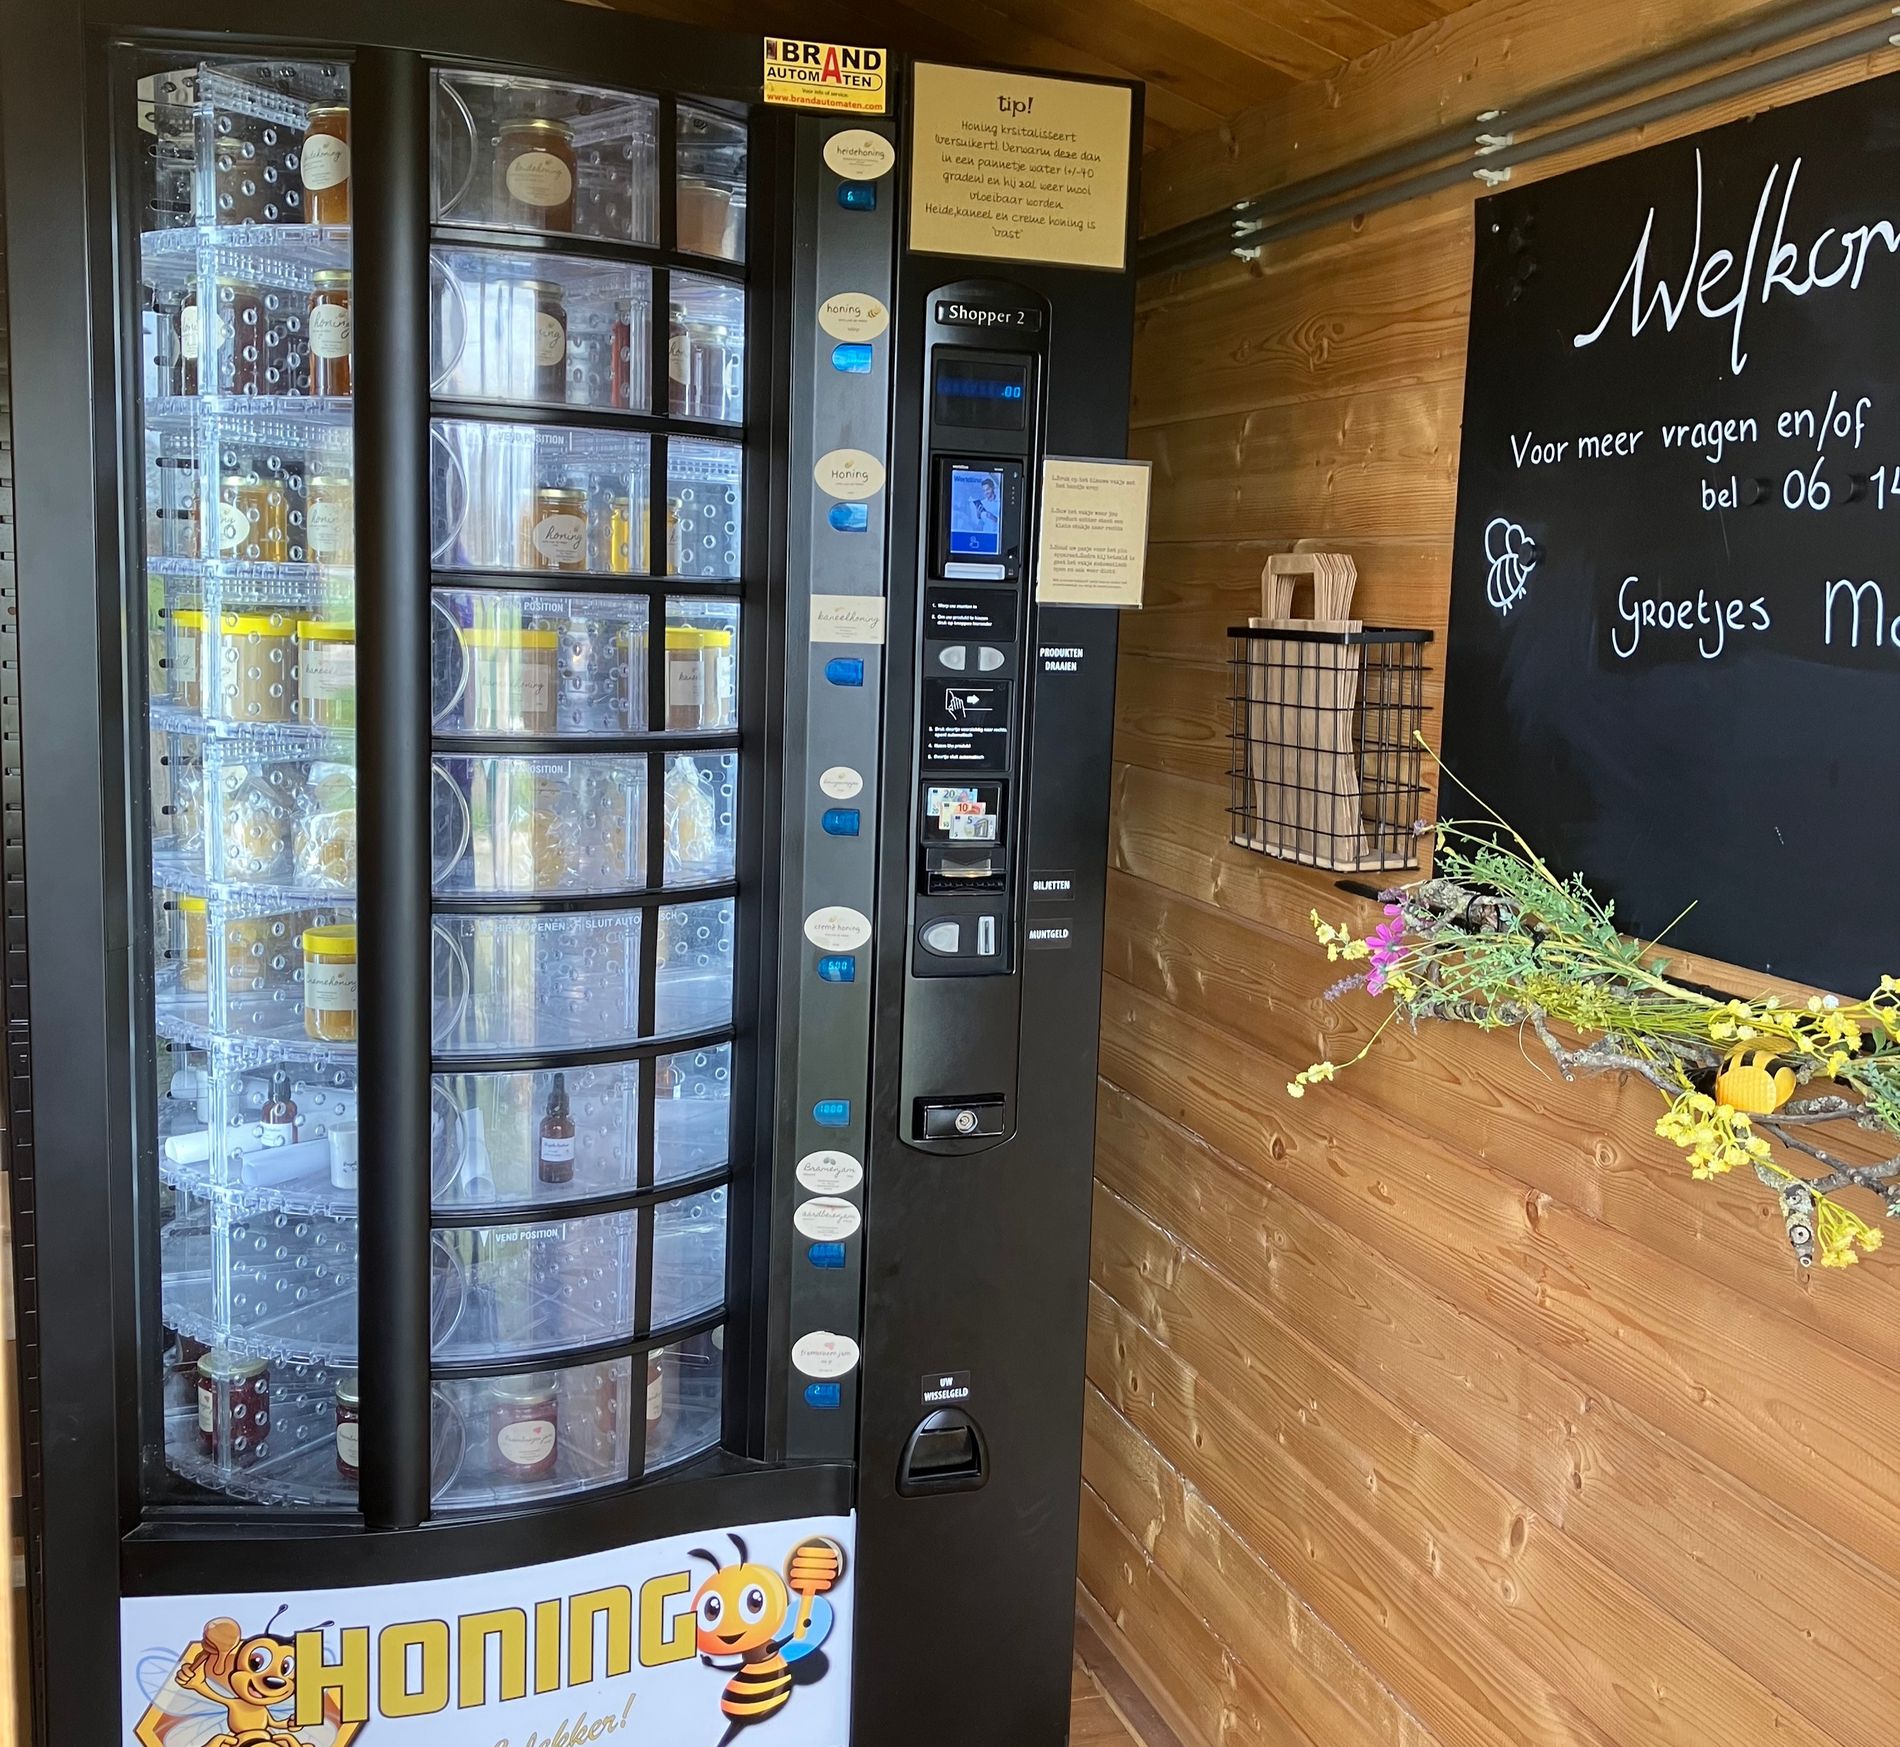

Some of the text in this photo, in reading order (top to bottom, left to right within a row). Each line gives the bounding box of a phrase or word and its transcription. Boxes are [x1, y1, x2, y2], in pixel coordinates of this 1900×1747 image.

[782, 41, 881, 84] BRAND
[767, 62, 872, 87] AUTOMATEN
[766, 93, 883, 111] www.brandautomaten.com
[997, 95, 1034, 117] tip!
[961, 120, 1077, 143] Honing krsitalisseert
[836, 145, 885, 160] heidehoning
[1002, 141, 1051, 157] Verwarm
[1053, 148, 1078, 160] deze
[1080, 150, 1101, 162] dan
[941, 154, 952, 163] in
[955, 156, 975, 165] een
[978, 158, 1026, 173] pannetje
[1029, 164, 1062, 175] water
[987, 177, 1000, 186] en
[1003, 176, 1017, 188] hij
[1018, 179, 1036, 190] zal
[1040, 182, 1065, 192] weer
[1066, 185, 1092, 196] mooi
[969, 191, 1023, 205] vloeibaar
[925, 202, 1097, 231] Heide,kaneel en creme honing is
[826, 303, 861, 318] honing
[948, 305, 1025, 326] Shopper 2
[1511, 390, 1871, 468] Voor meer vragen en/of
[526, 433, 565, 445] PSITION
[831, 469, 869, 483] Honing
[1701, 475, 1738, 511] bel
[1782, 456, 1831, 511] 06
[545, 525, 582, 550] honing
[524, 601, 564, 612] POSITION
[817, 609, 880, 629] kaneelhoning
[1612, 576, 1771, 659] Groetjes
[1039, 647, 1084, 658] PRODUKTEN
[1044, 661, 1077, 672] DRAAIEN
[525, 765, 564, 774] OSITION
[943, 790, 956, 799] 20
[958, 803, 968, 812] 10
[967, 816, 973, 824] 5
[1032, 880, 1071, 891] BILJETTEN
[585, 918, 613, 929] SLUIT
[837, 924, 861, 934] honing
[1028, 928, 1069, 940] MUNTGELD
[495, 1228, 558, 1242] VEND POSITION
[940, 1377, 954, 1387] UW
[923, 1387, 969, 1402] WISSELGELD
[295, 1570, 699, 1727] HONING
